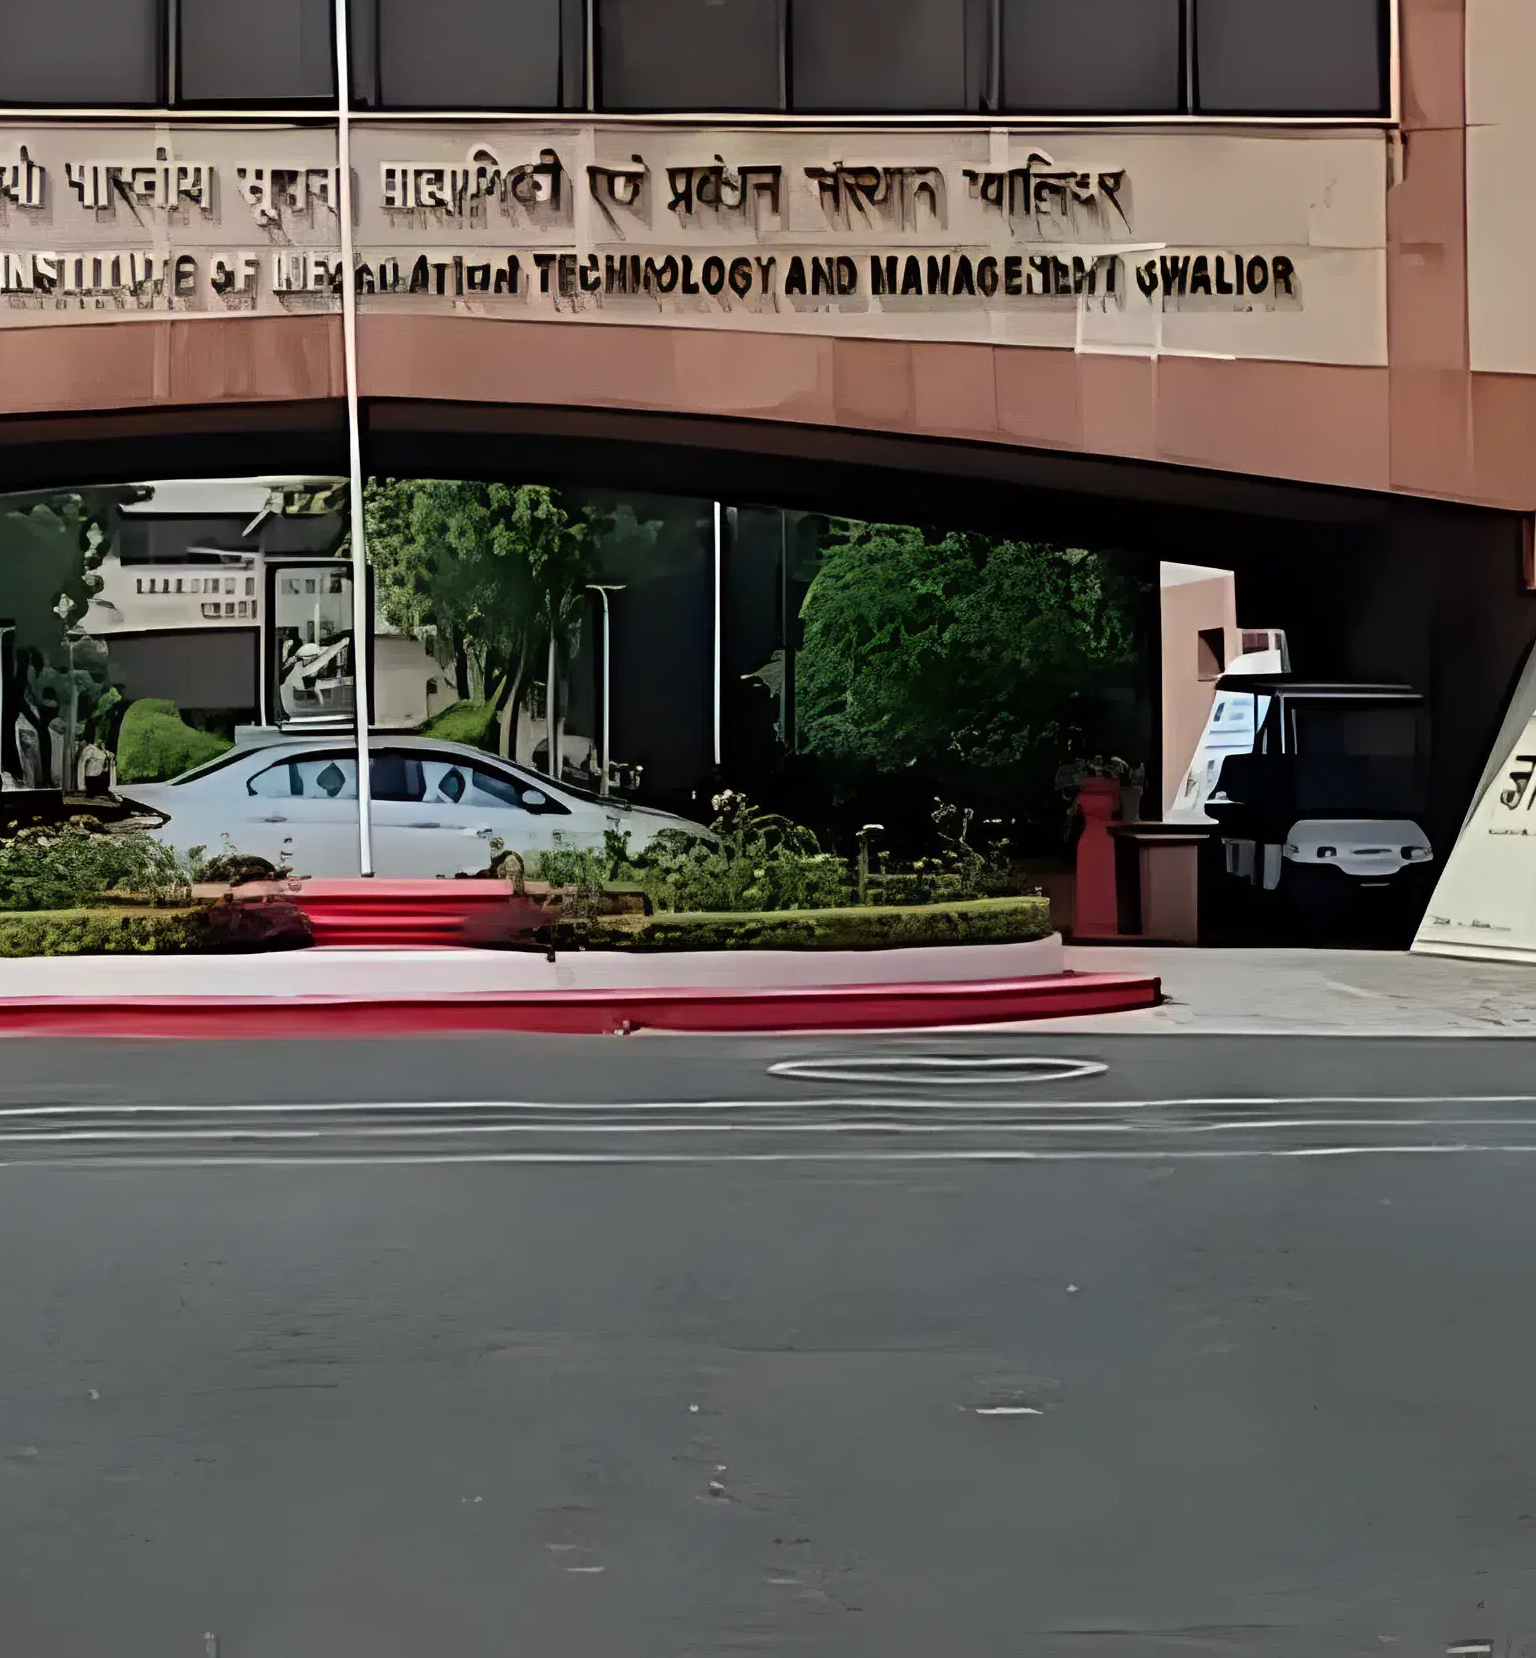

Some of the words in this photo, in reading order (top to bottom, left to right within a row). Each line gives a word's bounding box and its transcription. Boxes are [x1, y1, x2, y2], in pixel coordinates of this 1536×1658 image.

[533, 253, 778, 297] TECHNOLOGY
[785, 255, 858, 295] AND
[870, 254, 1119, 296] MANAGEMENT
[1135, 254, 1294, 297] GWALIOR
